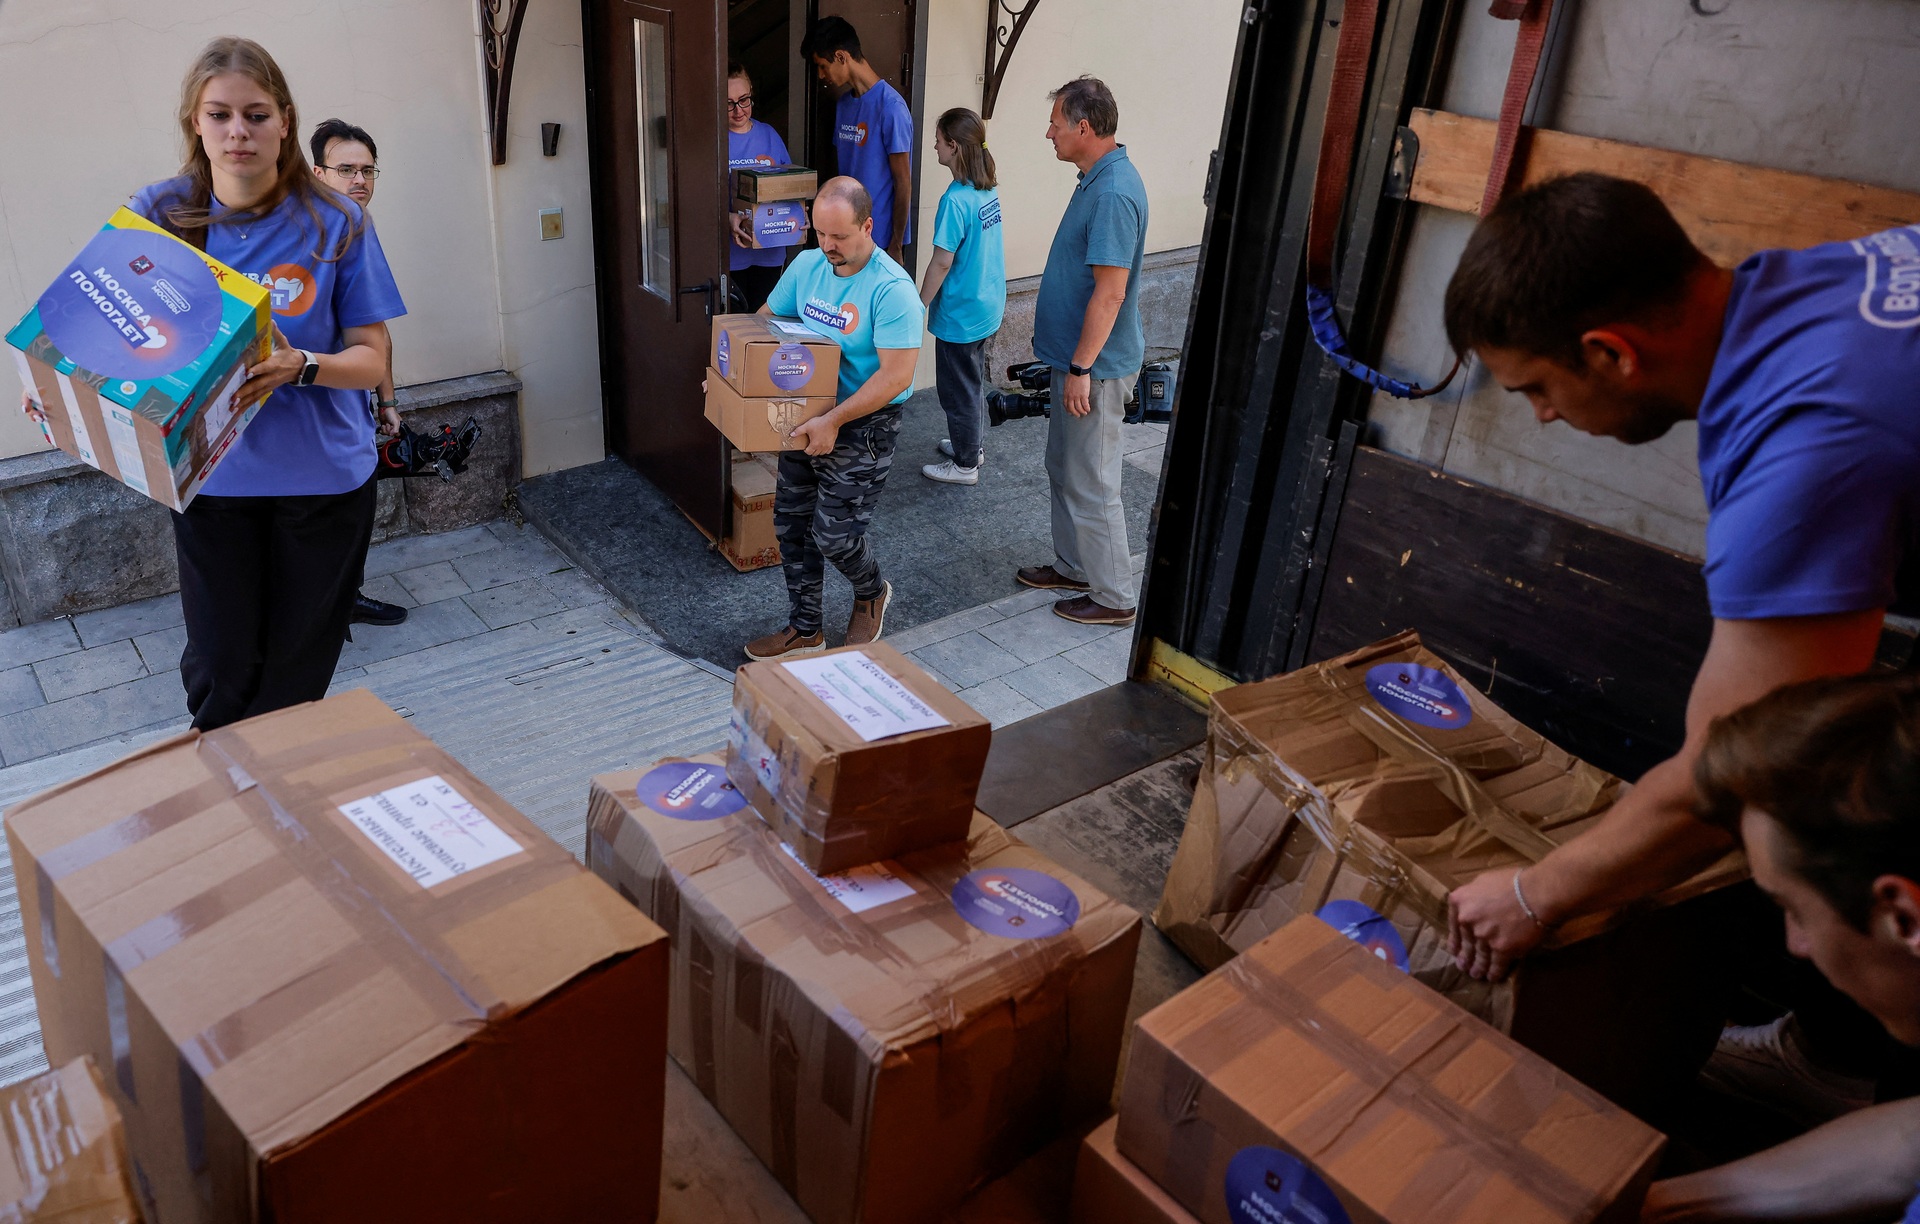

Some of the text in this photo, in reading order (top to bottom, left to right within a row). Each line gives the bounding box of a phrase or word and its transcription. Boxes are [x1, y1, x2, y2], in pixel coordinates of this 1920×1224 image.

[761, 226, 791, 235] ПОМОГАЕТ
[764, 220, 788, 228] МОСКВА
[69, 269, 145, 344] ПОМОГАЕТ
[93, 266, 152, 327] МОСКВА
[150, 285, 182, 316] МОСКВЫ
[804, 306, 846, 328] ПОМОГАЕТ
[1378, 685, 1441, 714] ПОМОГАЕТ
[1386, 681, 1435, 707] МОСКВА
[359, 816, 433, 882] Постельные
[412, 829, 468, 875] ушевые
[1000, 891, 1049, 919] МОСКВА
[1002, 882, 1065, 917] ПОМОГАЕТ
